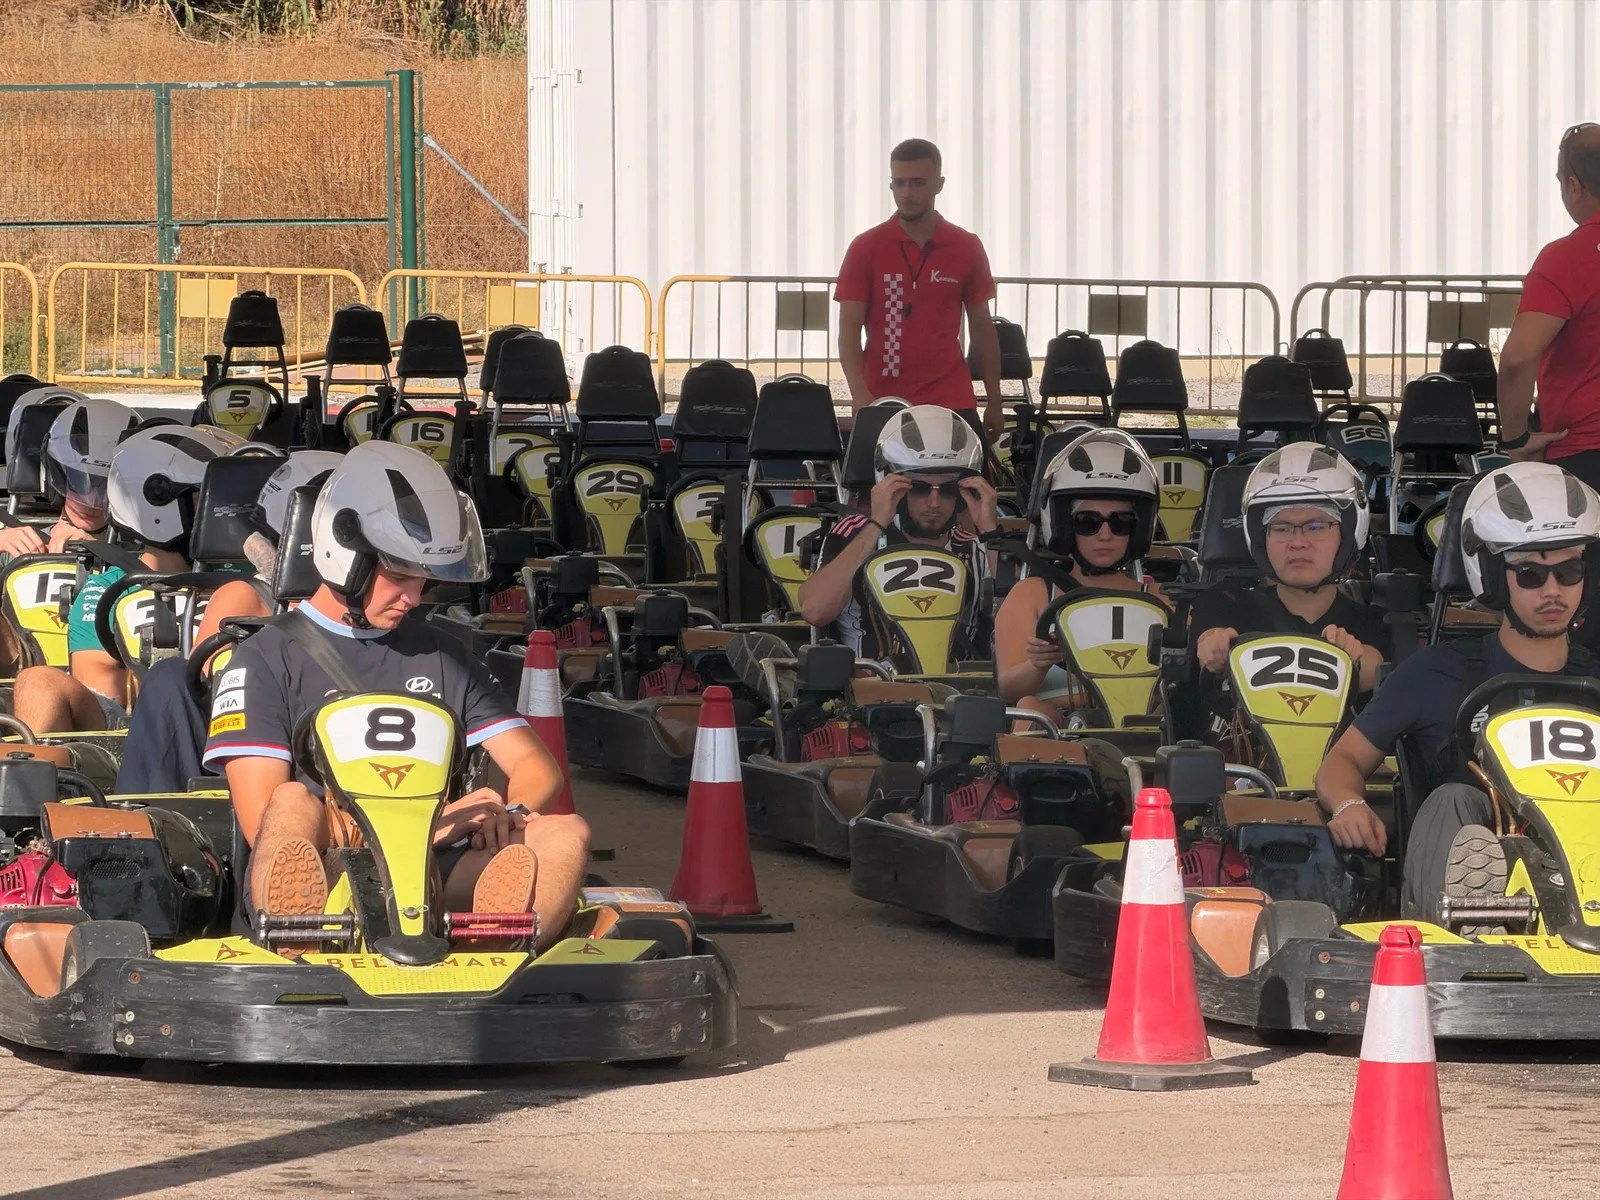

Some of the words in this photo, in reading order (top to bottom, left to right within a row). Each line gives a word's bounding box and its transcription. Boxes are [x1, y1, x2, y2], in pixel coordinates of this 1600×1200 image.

[228, 390, 251, 408] 5
[411, 422, 445, 442] 16
[1345, 427, 1386, 442] 56
[586, 469, 645, 497] 29
[1163, 462, 1182, 485] 11
[1525, 521, 1577, 533] LS2
[422, 545, 464, 555] LS2
[883, 558, 956, 593] 22
[1112, 606, 1124, 640] 1
[1250, 646, 1339, 690] 25
[364, 707, 416, 751] 8
[1529, 719, 1597, 761] 18
